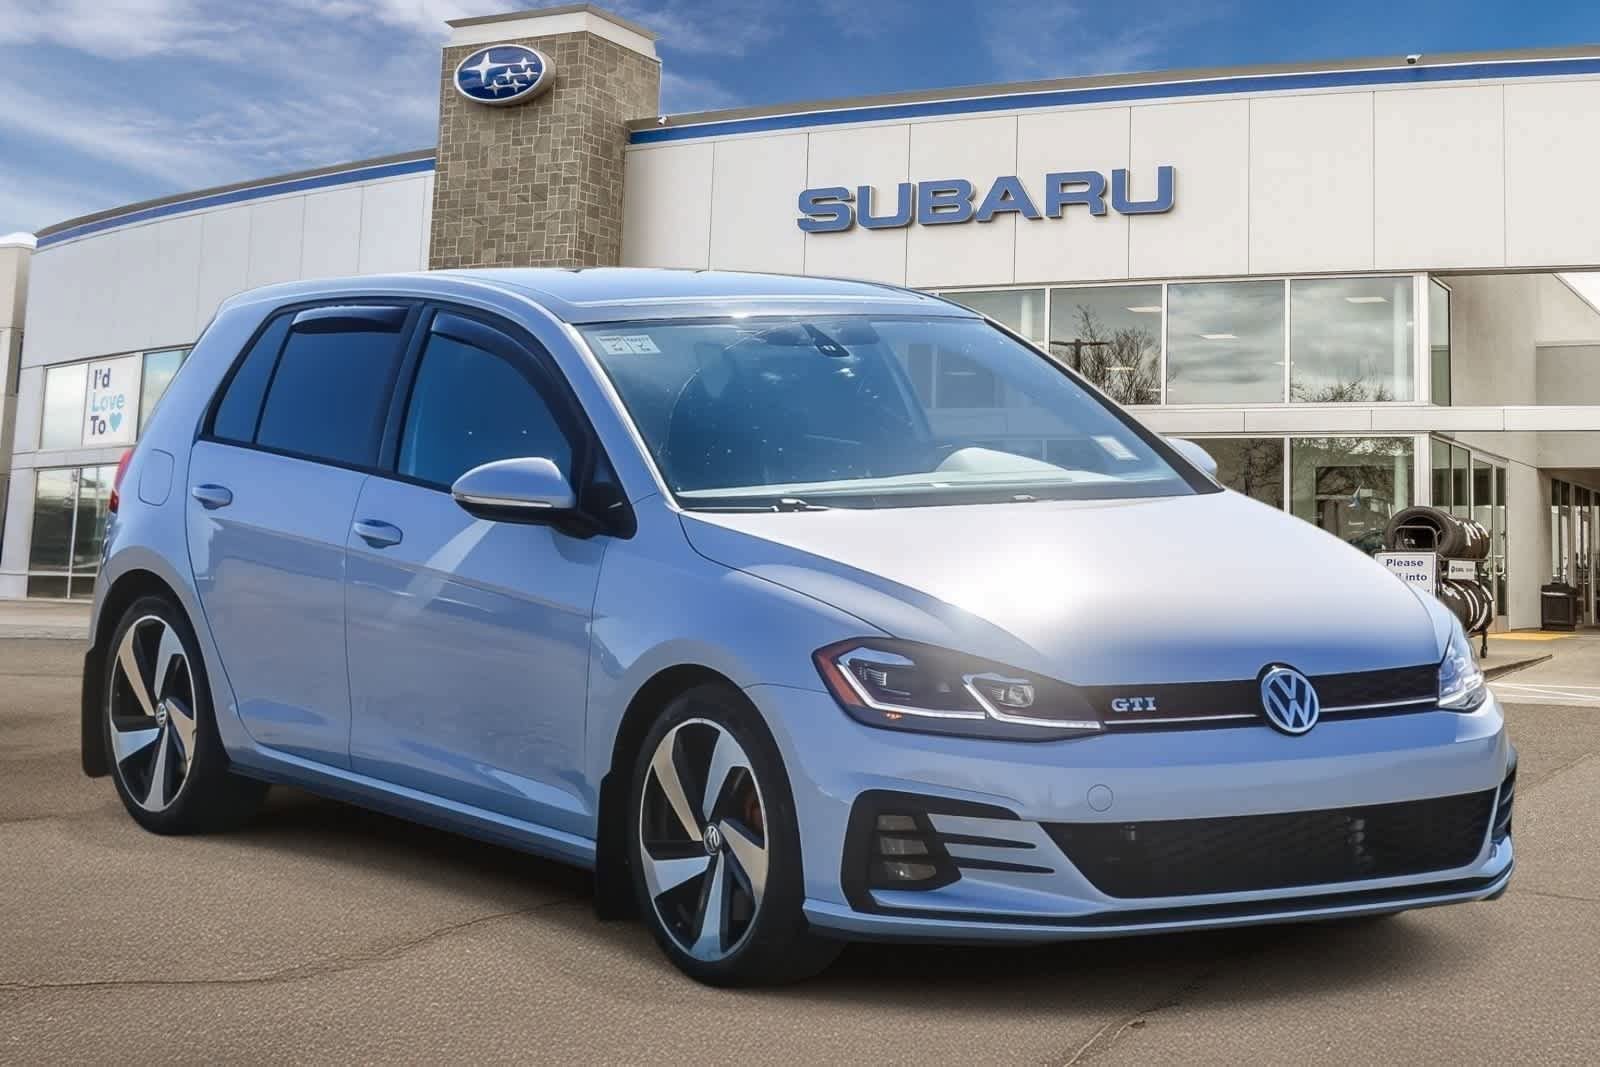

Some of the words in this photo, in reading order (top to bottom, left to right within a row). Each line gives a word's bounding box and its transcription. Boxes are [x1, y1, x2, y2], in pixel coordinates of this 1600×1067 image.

[797, 165, 1177, 233] SUBARU
[93, 367, 111, 390] I'd
[91, 392, 125, 412] Love
[90, 415, 106, 435] To
[1386, 558, 1424, 567] Please
[1405, 572, 1428, 581] into
[1111, 696, 1157, 712] GTI
[1262, 670, 1319, 733] VW
